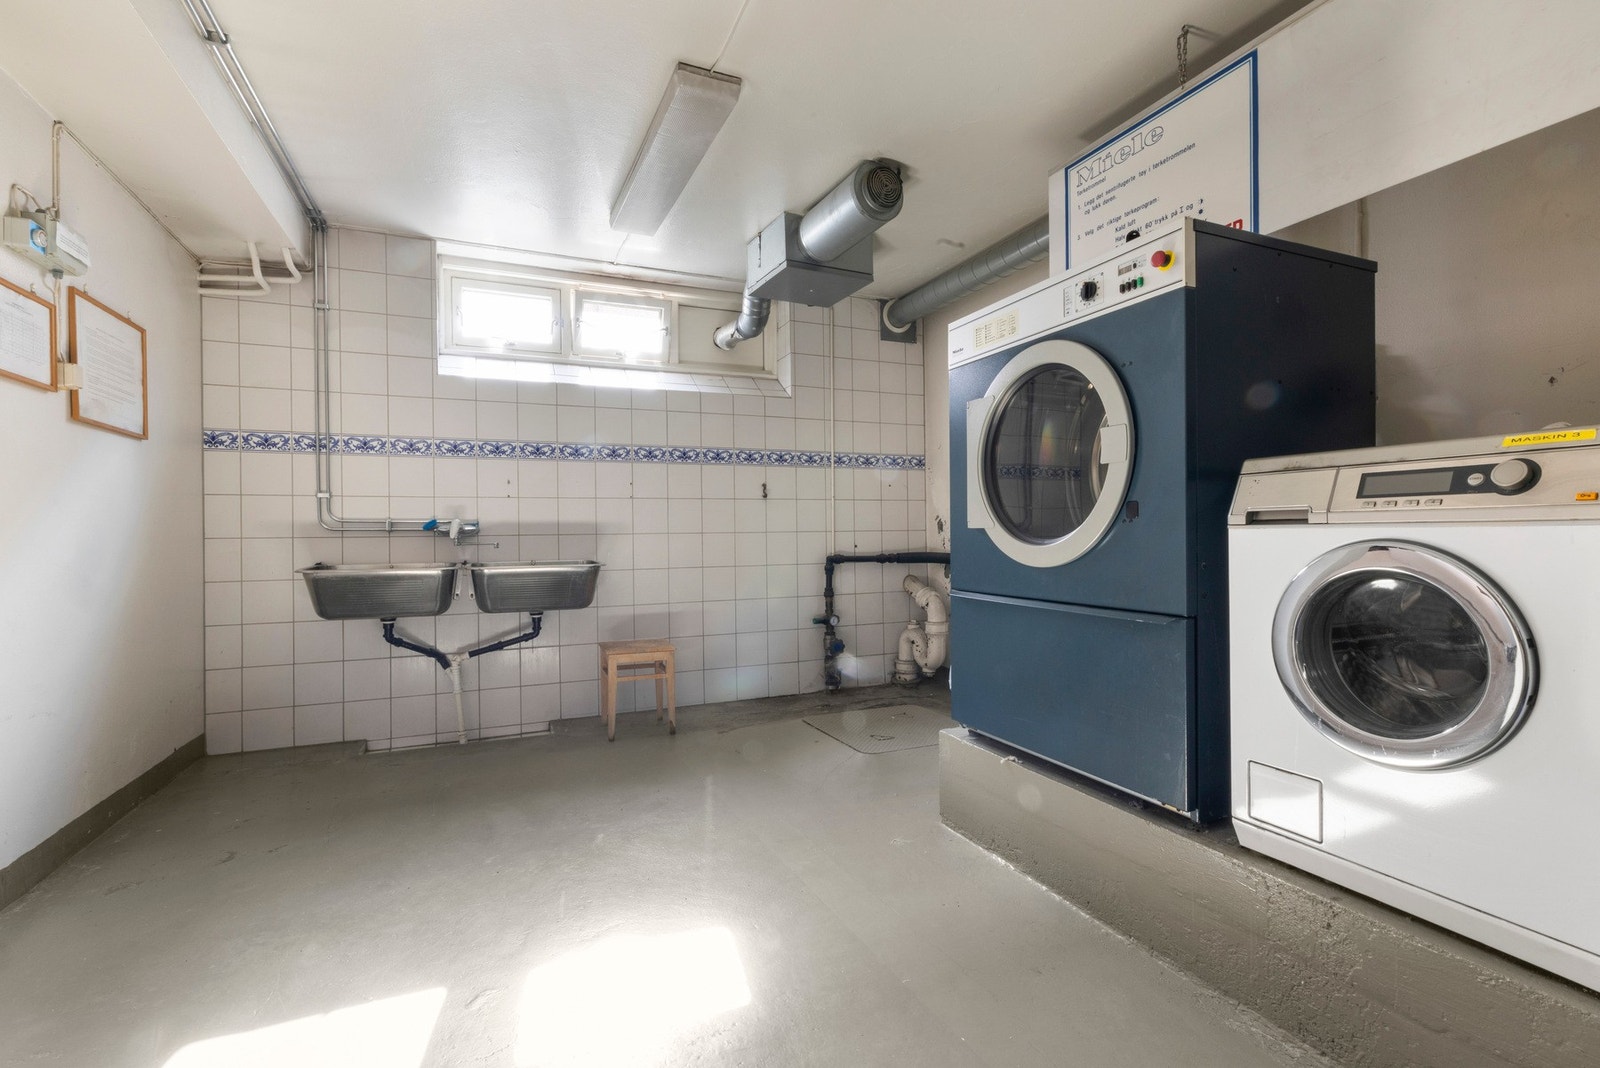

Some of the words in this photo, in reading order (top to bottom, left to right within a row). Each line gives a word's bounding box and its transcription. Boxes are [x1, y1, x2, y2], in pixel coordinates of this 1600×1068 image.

[1076, 125, 1164, 188] Miele
[1084, 197, 1095, 207] Legg
[1096, 192, 1104, 200] det
[1185, 203, 1194, 212] og
[1511, 433, 1567, 443] MASKIN
